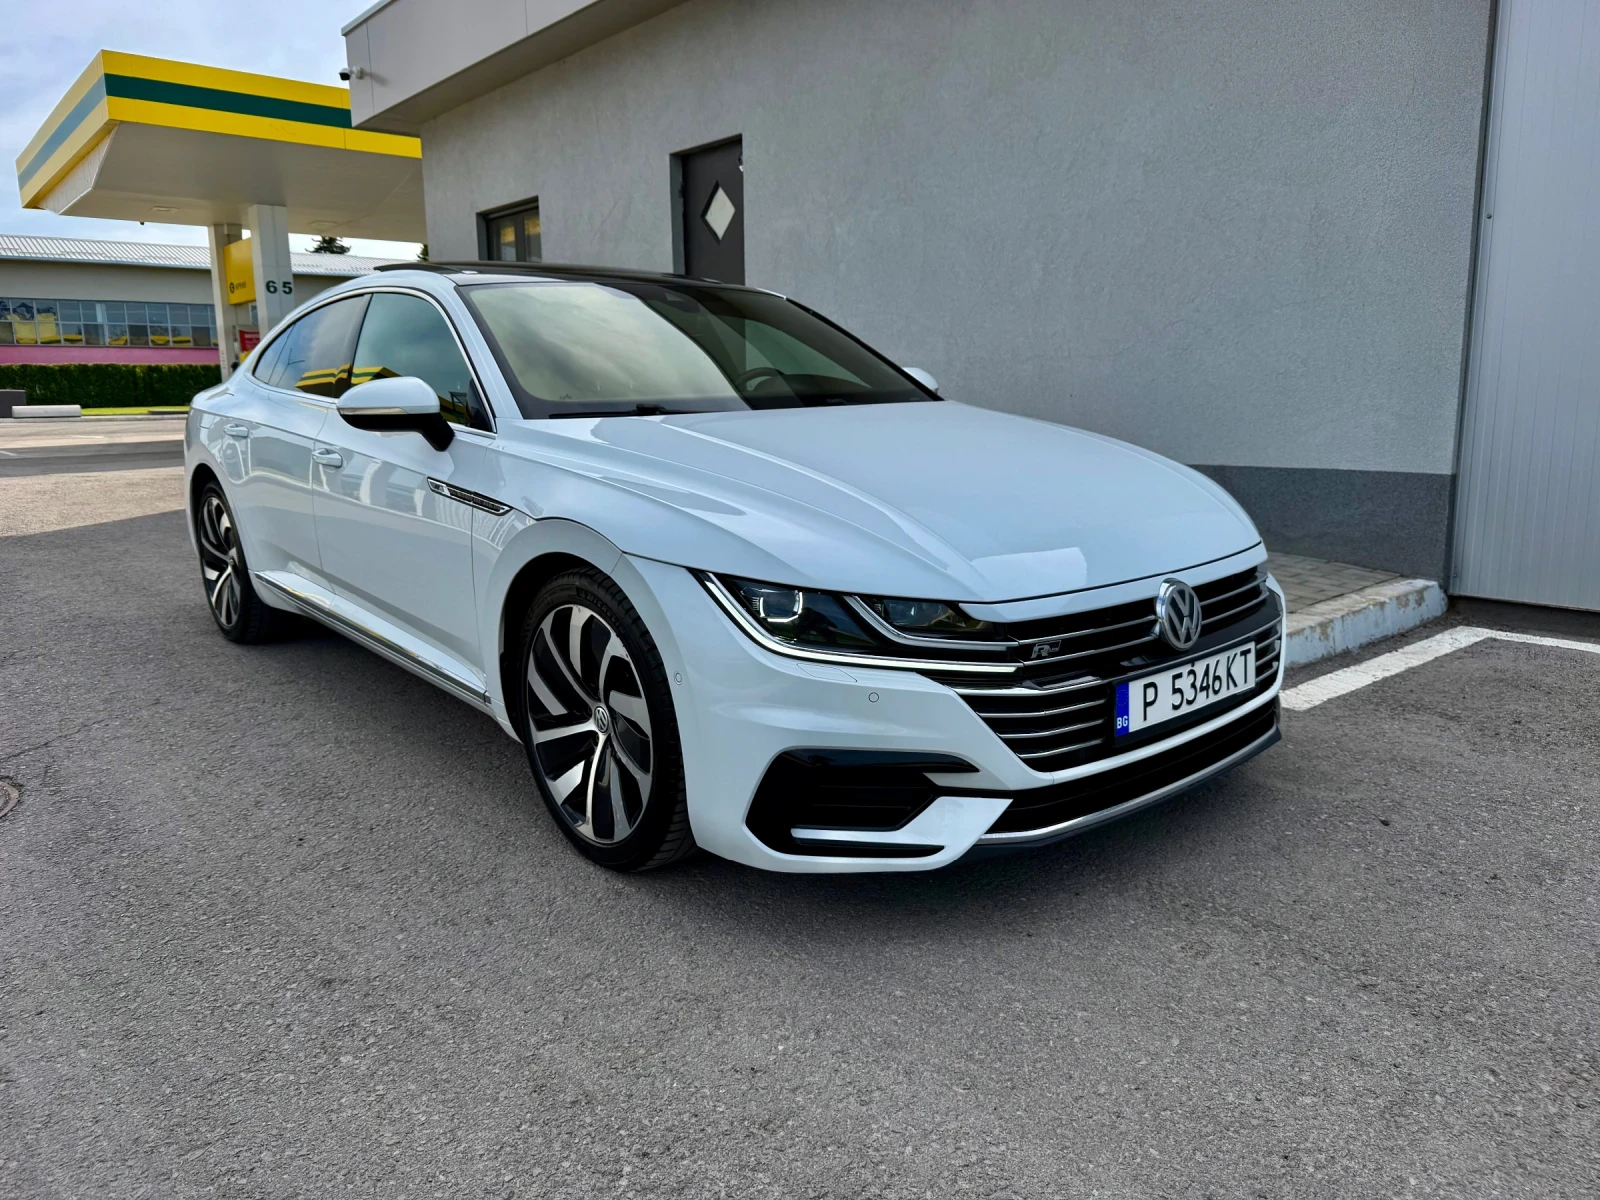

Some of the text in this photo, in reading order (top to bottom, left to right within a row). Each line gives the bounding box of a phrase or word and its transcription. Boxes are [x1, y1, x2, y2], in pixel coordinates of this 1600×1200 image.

[1142, 647, 1252, 722] P 5346KT
[1116, 715, 1129, 729] BG
